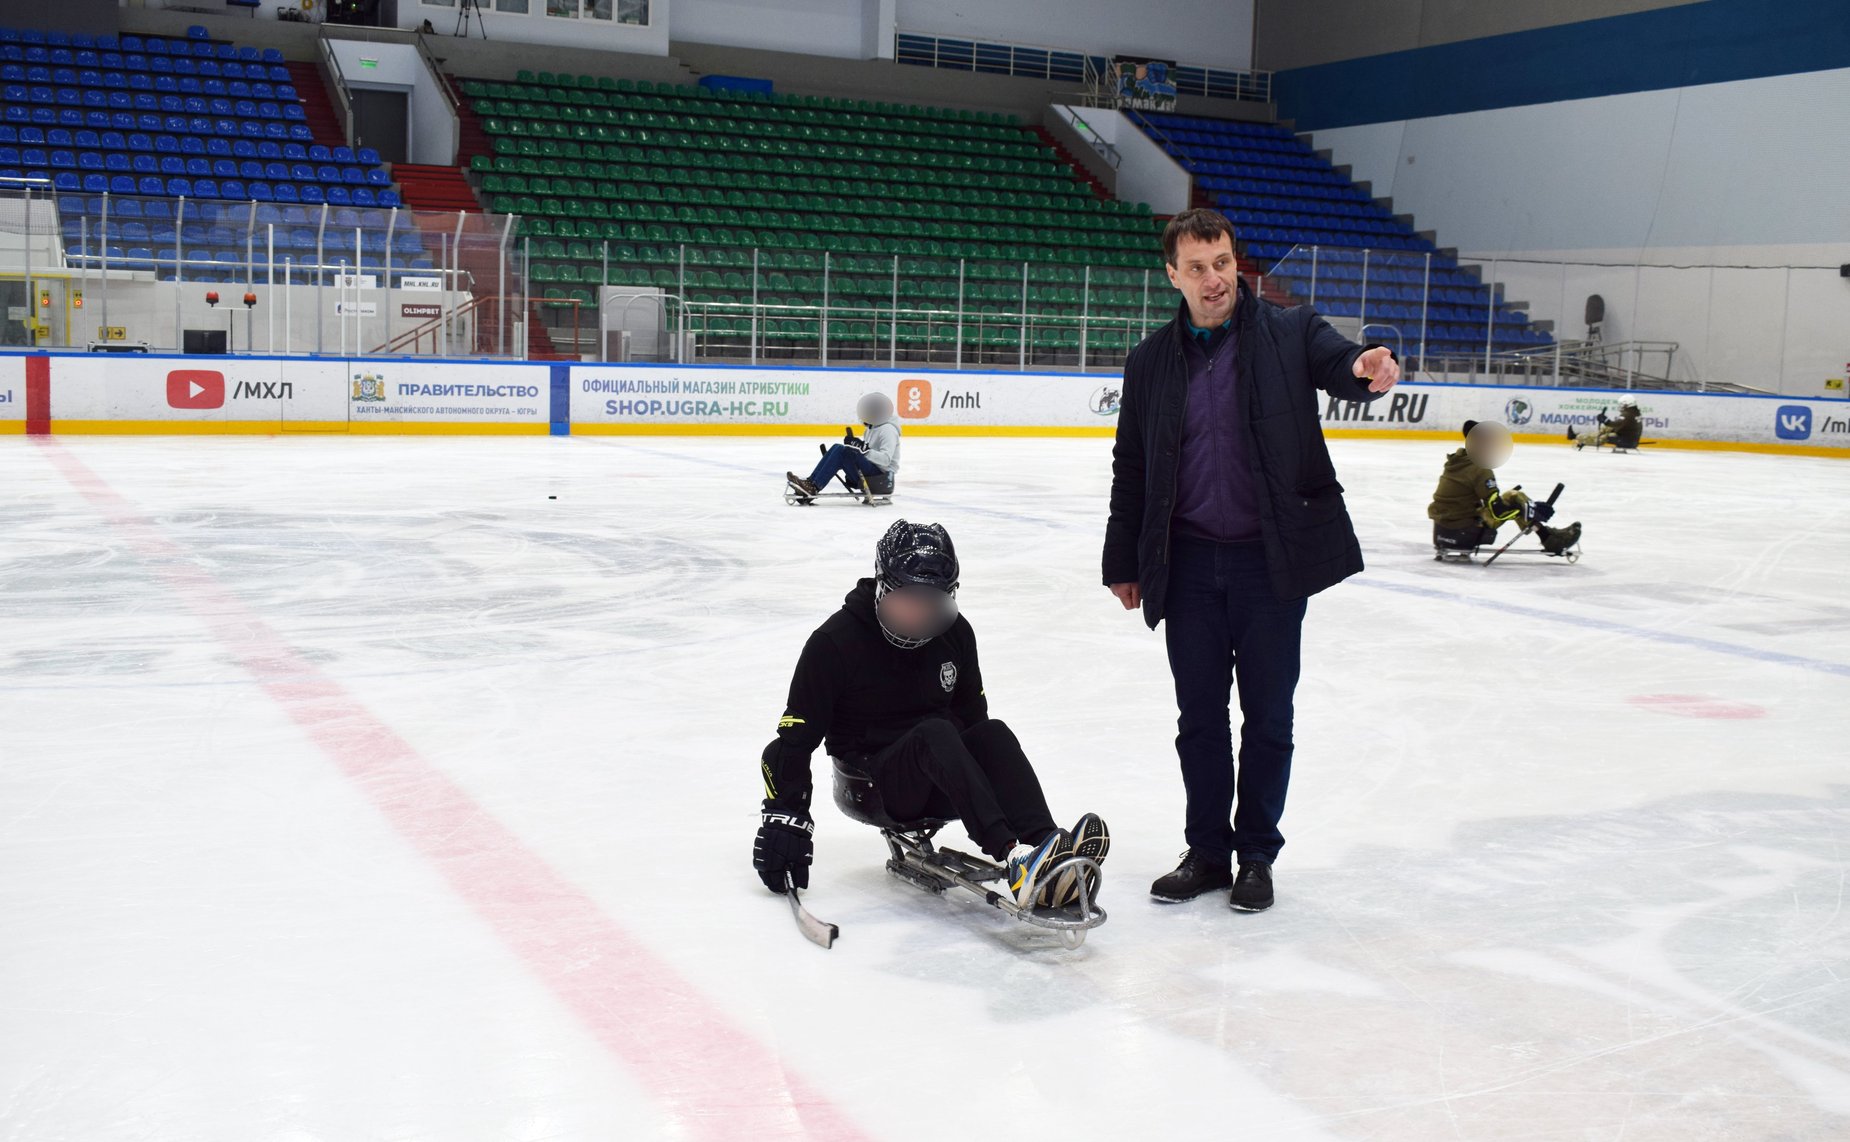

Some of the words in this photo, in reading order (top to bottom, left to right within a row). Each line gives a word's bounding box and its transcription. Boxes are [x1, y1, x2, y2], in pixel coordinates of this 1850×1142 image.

[403, 306, 440, 315] OLIMPBET
[233, 380, 293, 400] /МХЛ
[398, 383, 539, 398] ПРАВИТЕЛЬСТВО
[582, 379, 680, 395] ОФИЦИАЛЬНЫЙ
[683, 381, 736, 395] МАГАЗИН
[738, 382, 810, 396] АТРИБУТИКИ
[605, 399, 789, 417] SHOP.UGRA-HC.RU
[940, 390, 981, 409] /mhl
[356, 405, 434, 415] ХАНТЫ-МАНСИЙСКОГО
[435, 407, 485, 416] АВТОНОМНОГО
[485, 407, 511, 416] ОКРУГА
[517, 408, 538, 416] ЮГРЫ
